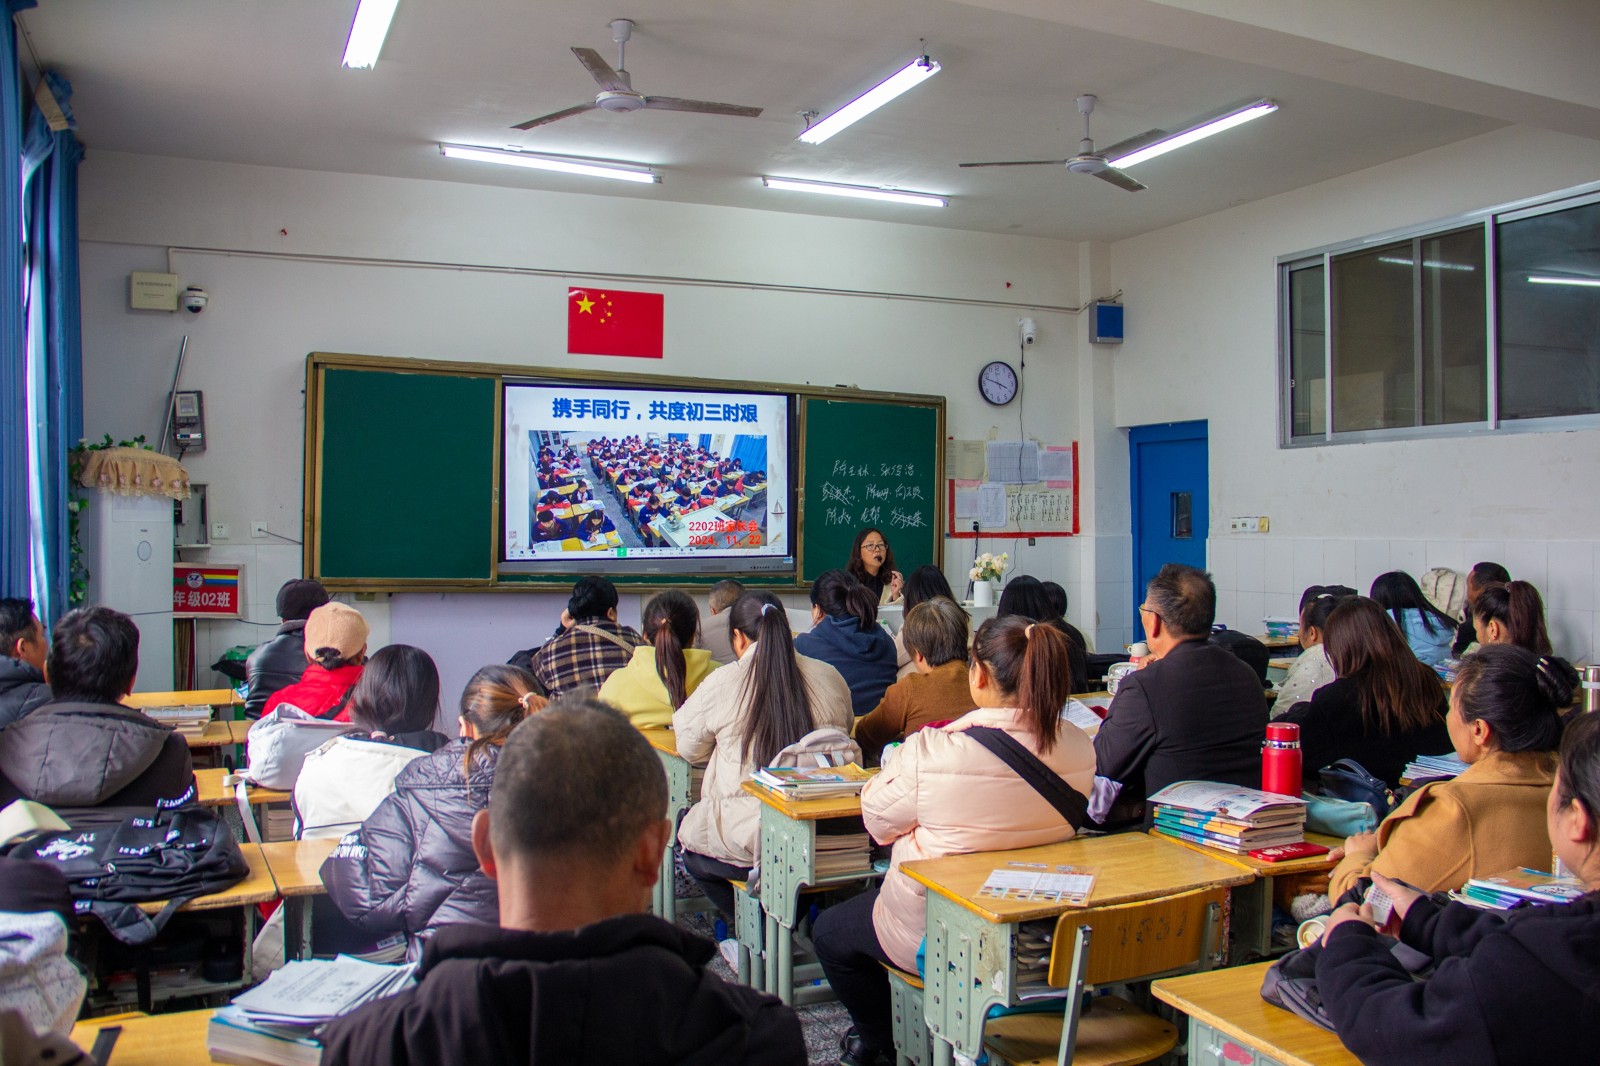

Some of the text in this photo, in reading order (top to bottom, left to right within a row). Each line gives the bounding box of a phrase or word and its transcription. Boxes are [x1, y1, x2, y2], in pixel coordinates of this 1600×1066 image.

[552, 397, 759, 422] 携手同行，共度初三时艰
[688, 519, 759, 532] 2202班家长会
[173, 590, 230, 607] 年级02班
